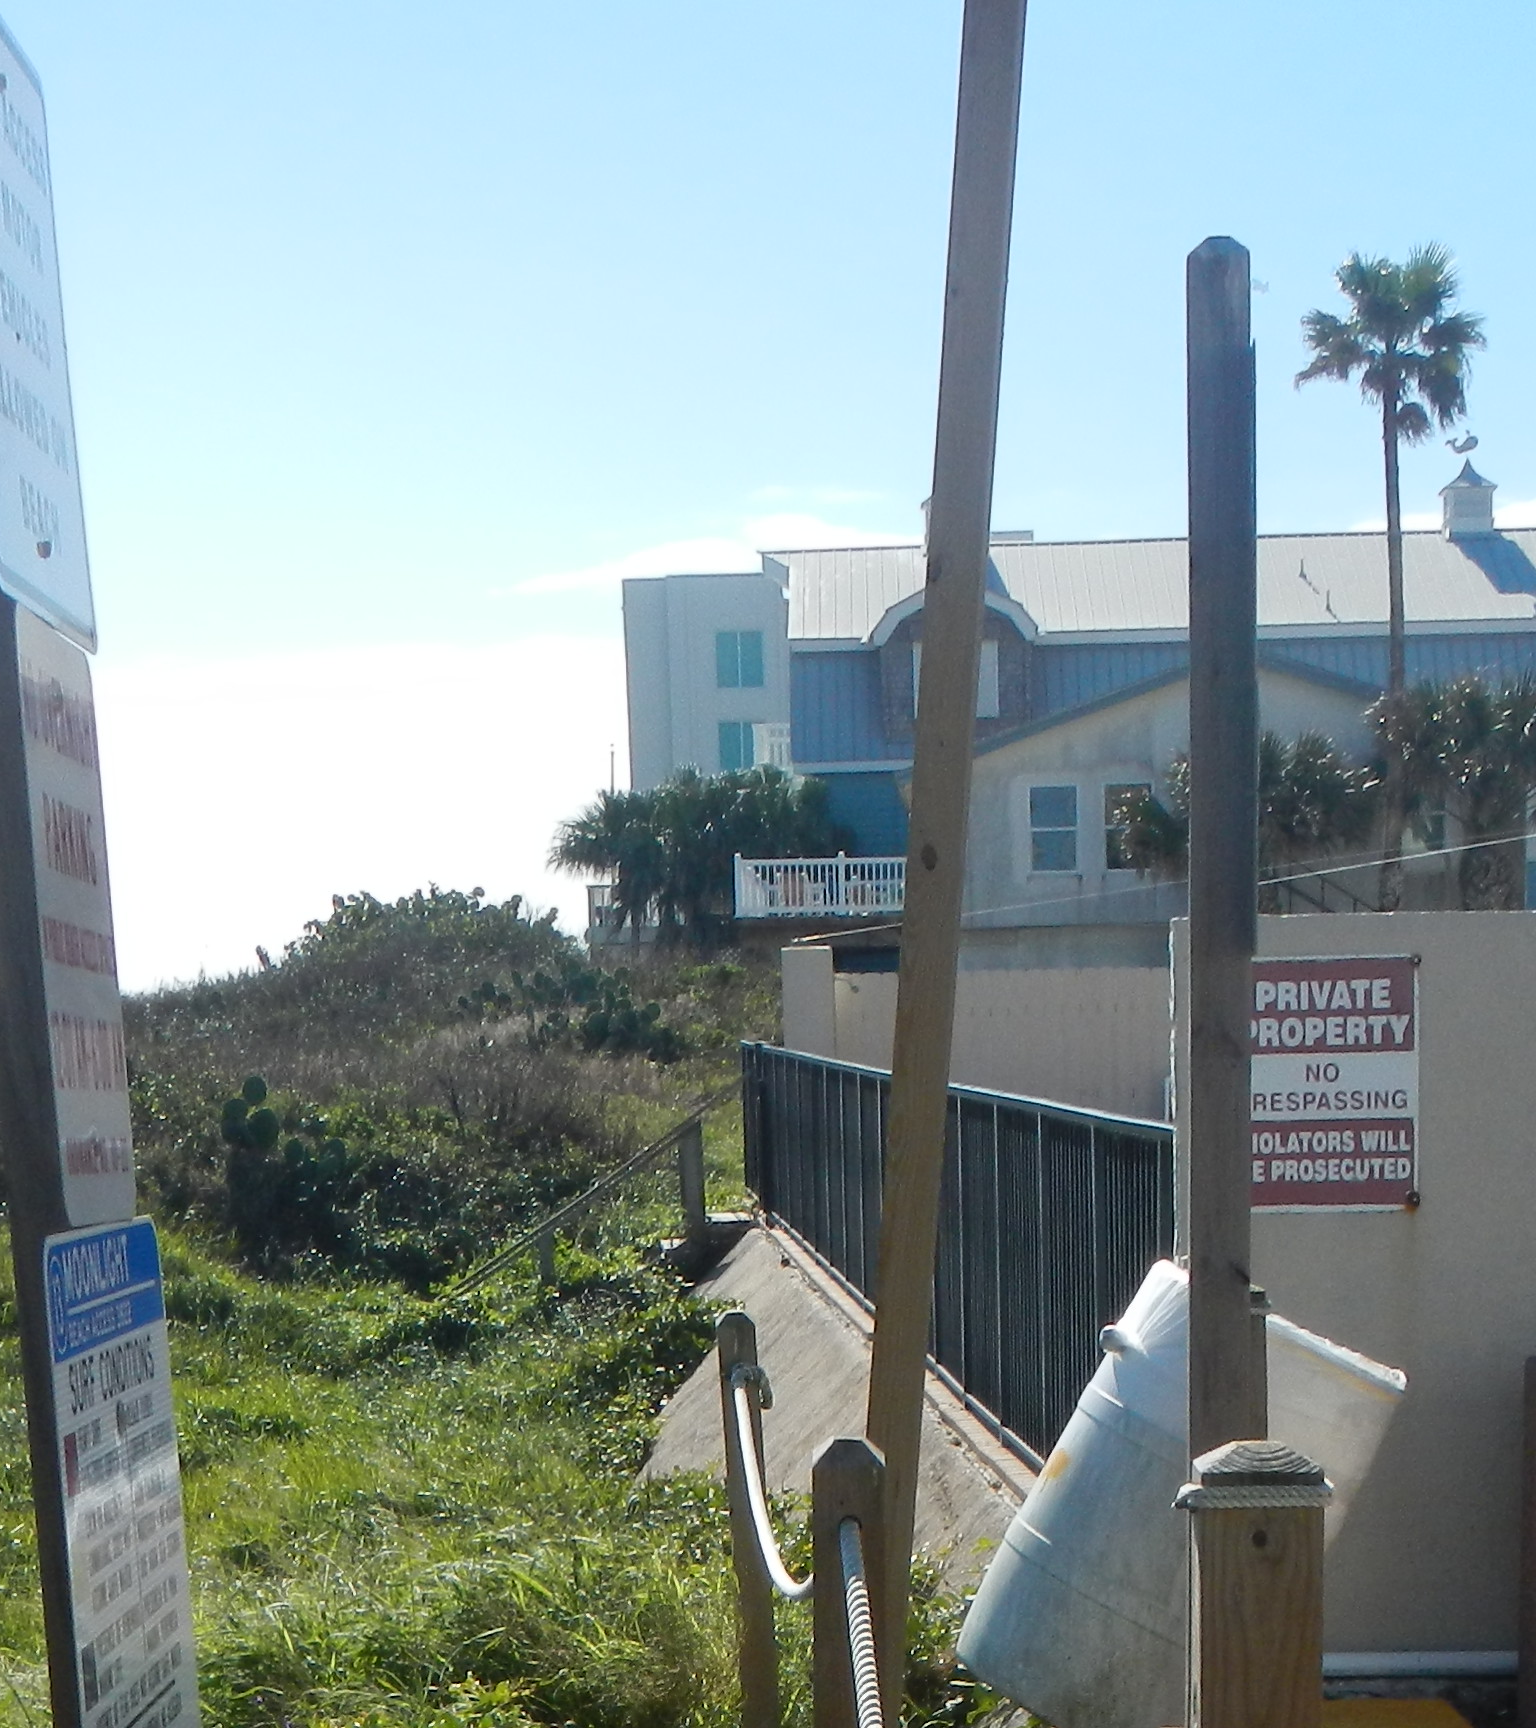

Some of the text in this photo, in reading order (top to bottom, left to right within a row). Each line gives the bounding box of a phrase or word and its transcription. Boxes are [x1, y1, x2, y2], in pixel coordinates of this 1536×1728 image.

[1255, 978, 1391, 1012] PRIVATE
[1305, 1063, 1340, 1083] NO
[1252, 1090, 1408, 1112] RESPASSING
[1252, 1129, 1411, 1155] IOLATORS WILL
[1270, 1158, 1411, 1182] PROSECUTED
[63, 1234, 129, 1302] MOONLIGHT
[68, 1354, 95, 1416] SURF
[99, 1334, 156, 1400] CONDITIONS
